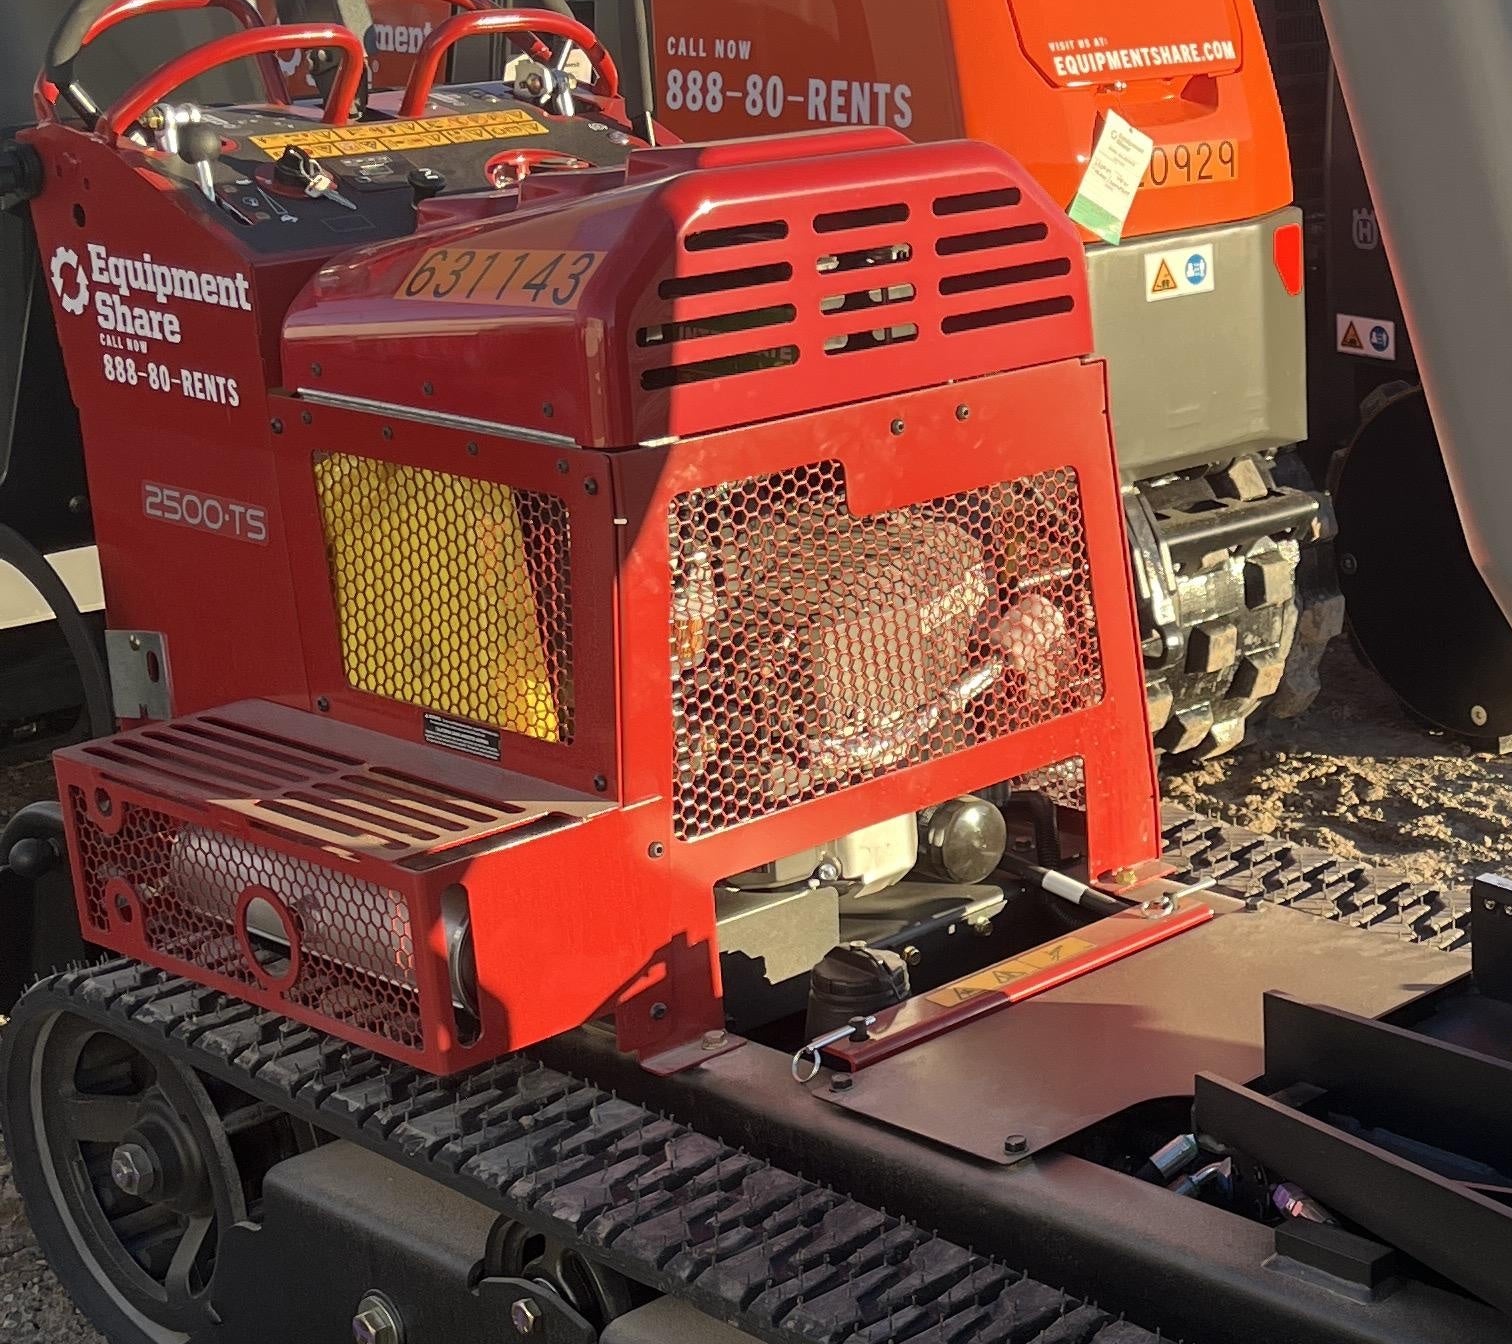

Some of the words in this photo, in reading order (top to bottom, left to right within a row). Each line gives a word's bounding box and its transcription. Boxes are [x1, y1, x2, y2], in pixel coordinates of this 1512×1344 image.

[667, 36, 706, 57] CALL
[715, 39, 751, 60] NOW
[1048, 40, 1074, 52] VISIT
[1053, 41, 1236, 76] EQUIPMENTSHARE.COM
[666, 68, 913, 129] 888-80-RENTS
[87, 242, 252, 311] Equipment
[405, 249, 596, 306] 631143
[95, 291, 181, 344] Share
[100, 333, 124, 350] CALL
[126, 337, 148, 354] NOW
[103, 353, 240, 407] 888-80-RENTS
